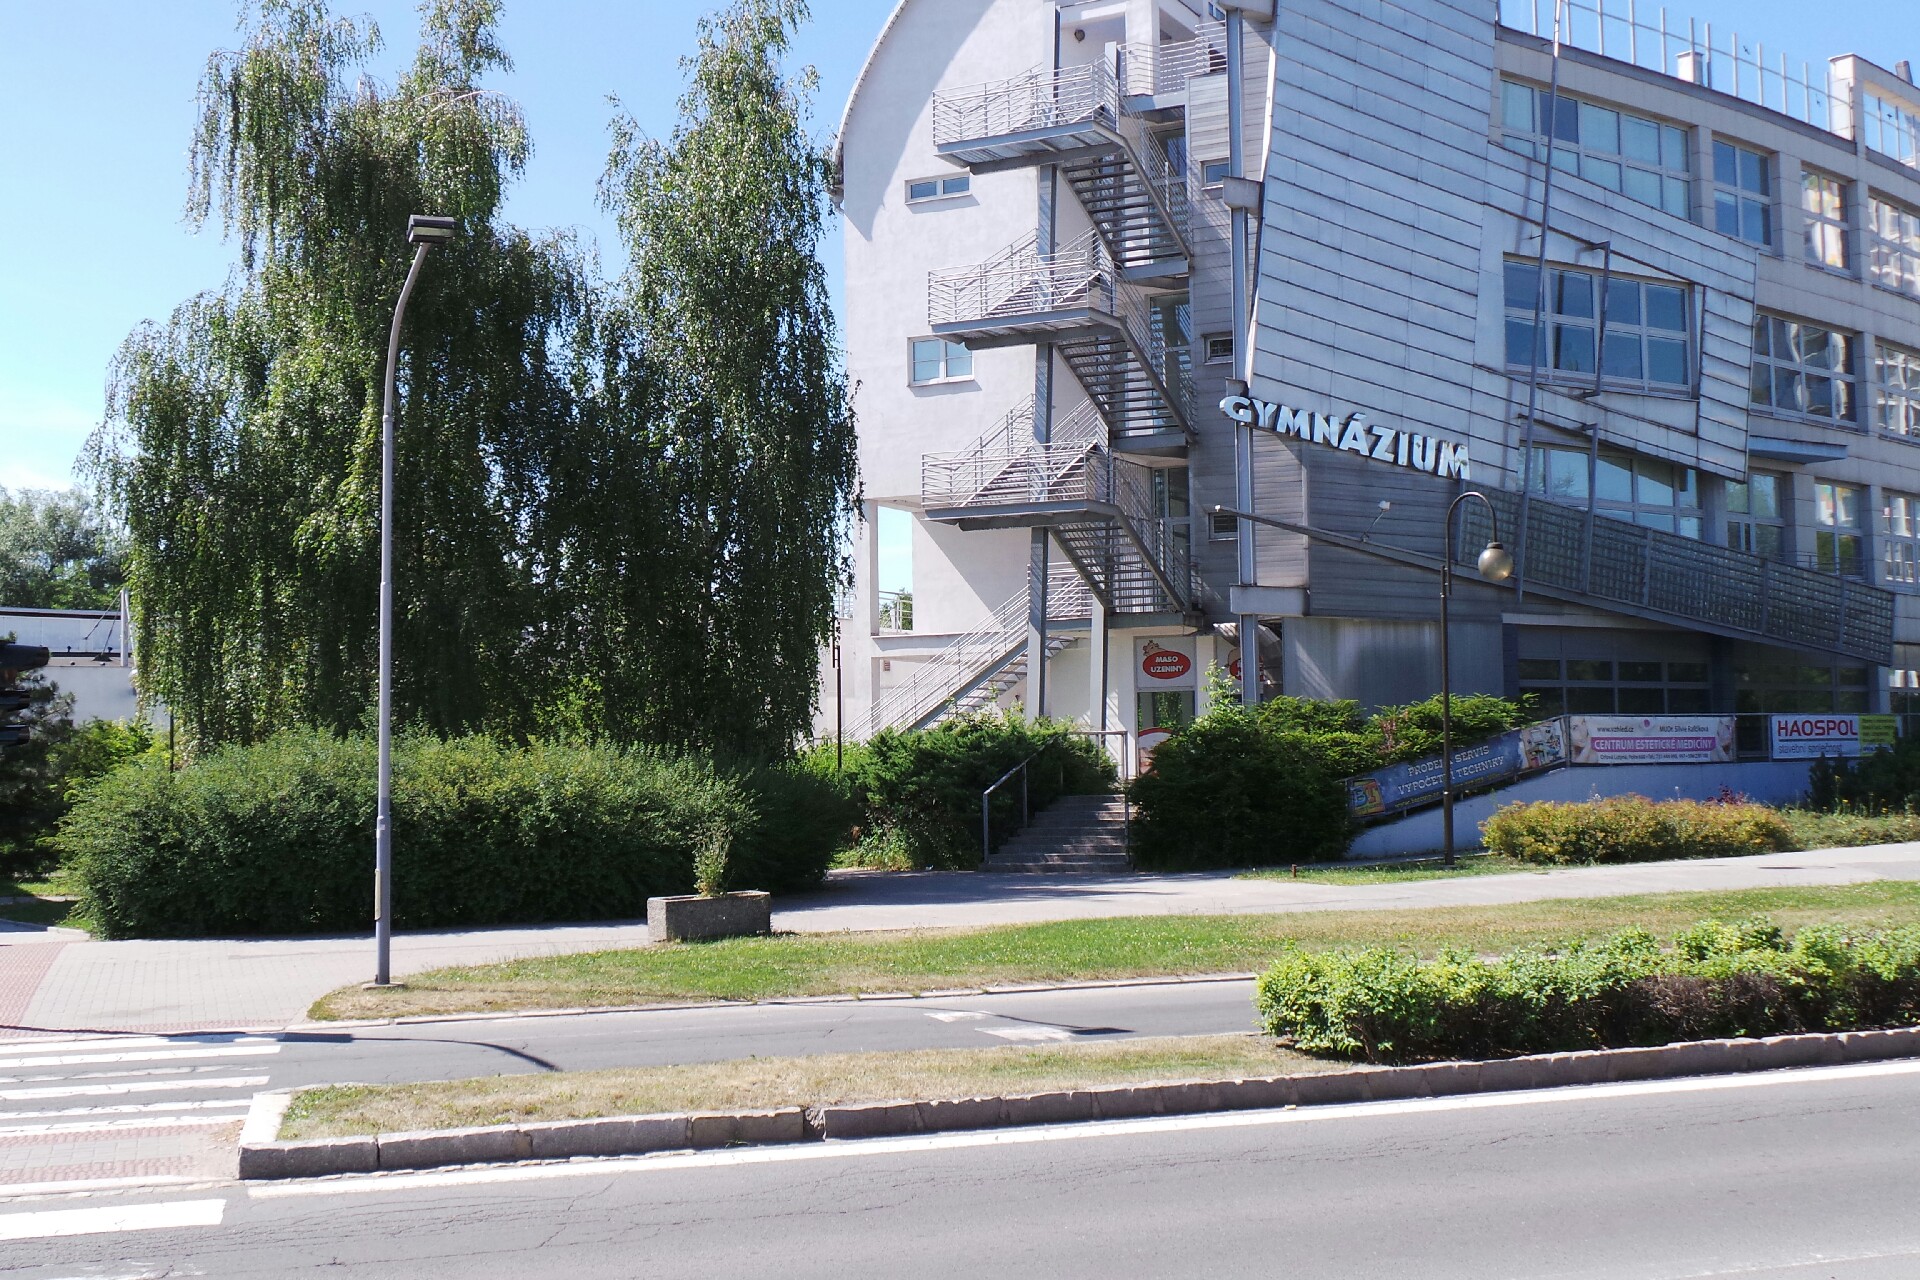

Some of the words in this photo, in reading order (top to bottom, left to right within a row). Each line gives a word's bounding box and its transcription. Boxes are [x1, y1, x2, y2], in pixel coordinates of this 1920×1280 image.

[1219, 395, 1471, 480] GYMNÁZIUM
[1151, 665, 1183, 673] UZENINY
[1777, 720, 1858, 737] HAOSPOL
[1594, 739, 1634, 750] CENTRUM
[1636, 738, 1676, 750] ESTETICKÉ
[1677, 737, 1713, 749] MEDICÍNY
[1779, 744, 1806, 754] stavební
[1808, 743, 1843, 754] společnost
[1407, 759, 1443, 777] PRODEJ
[1454, 745, 1490, 763] SERVIS
[1456, 756, 1504, 778] TECHNIKY
